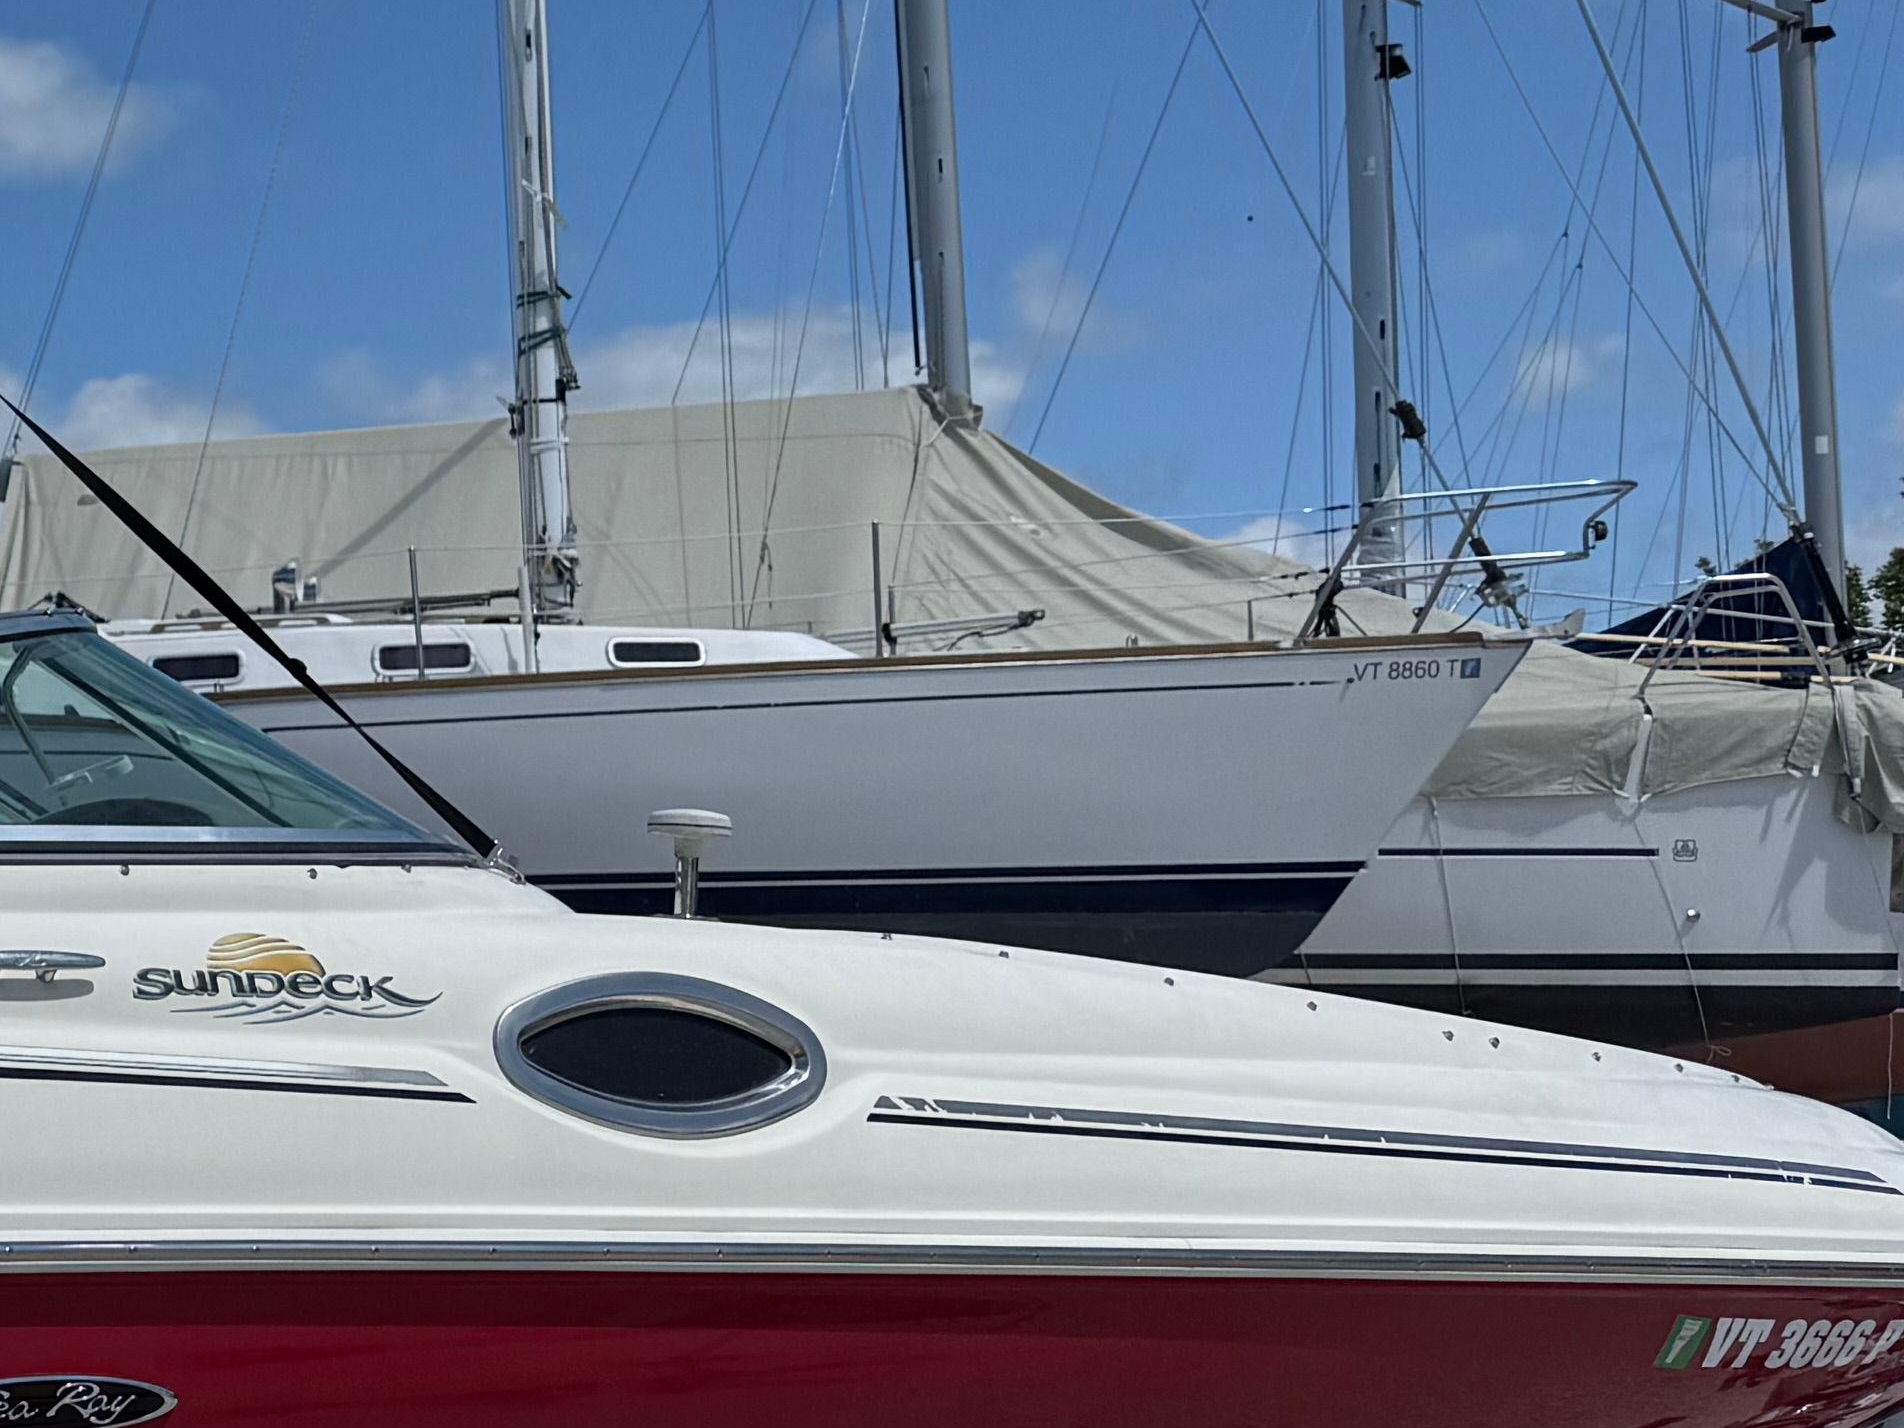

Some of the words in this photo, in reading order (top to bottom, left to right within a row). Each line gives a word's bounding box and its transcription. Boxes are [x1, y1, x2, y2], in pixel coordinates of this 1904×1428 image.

[1353, 662, 1383, 682] VT
[1388, 659, 1441, 681] 8860
[1446, 658, 1460, 679] T
[1702, 1317, 1776, 1369] VT
[1764, 1319, 1877, 1369] 3666
[45, 1382, 136, 1425] Ray
